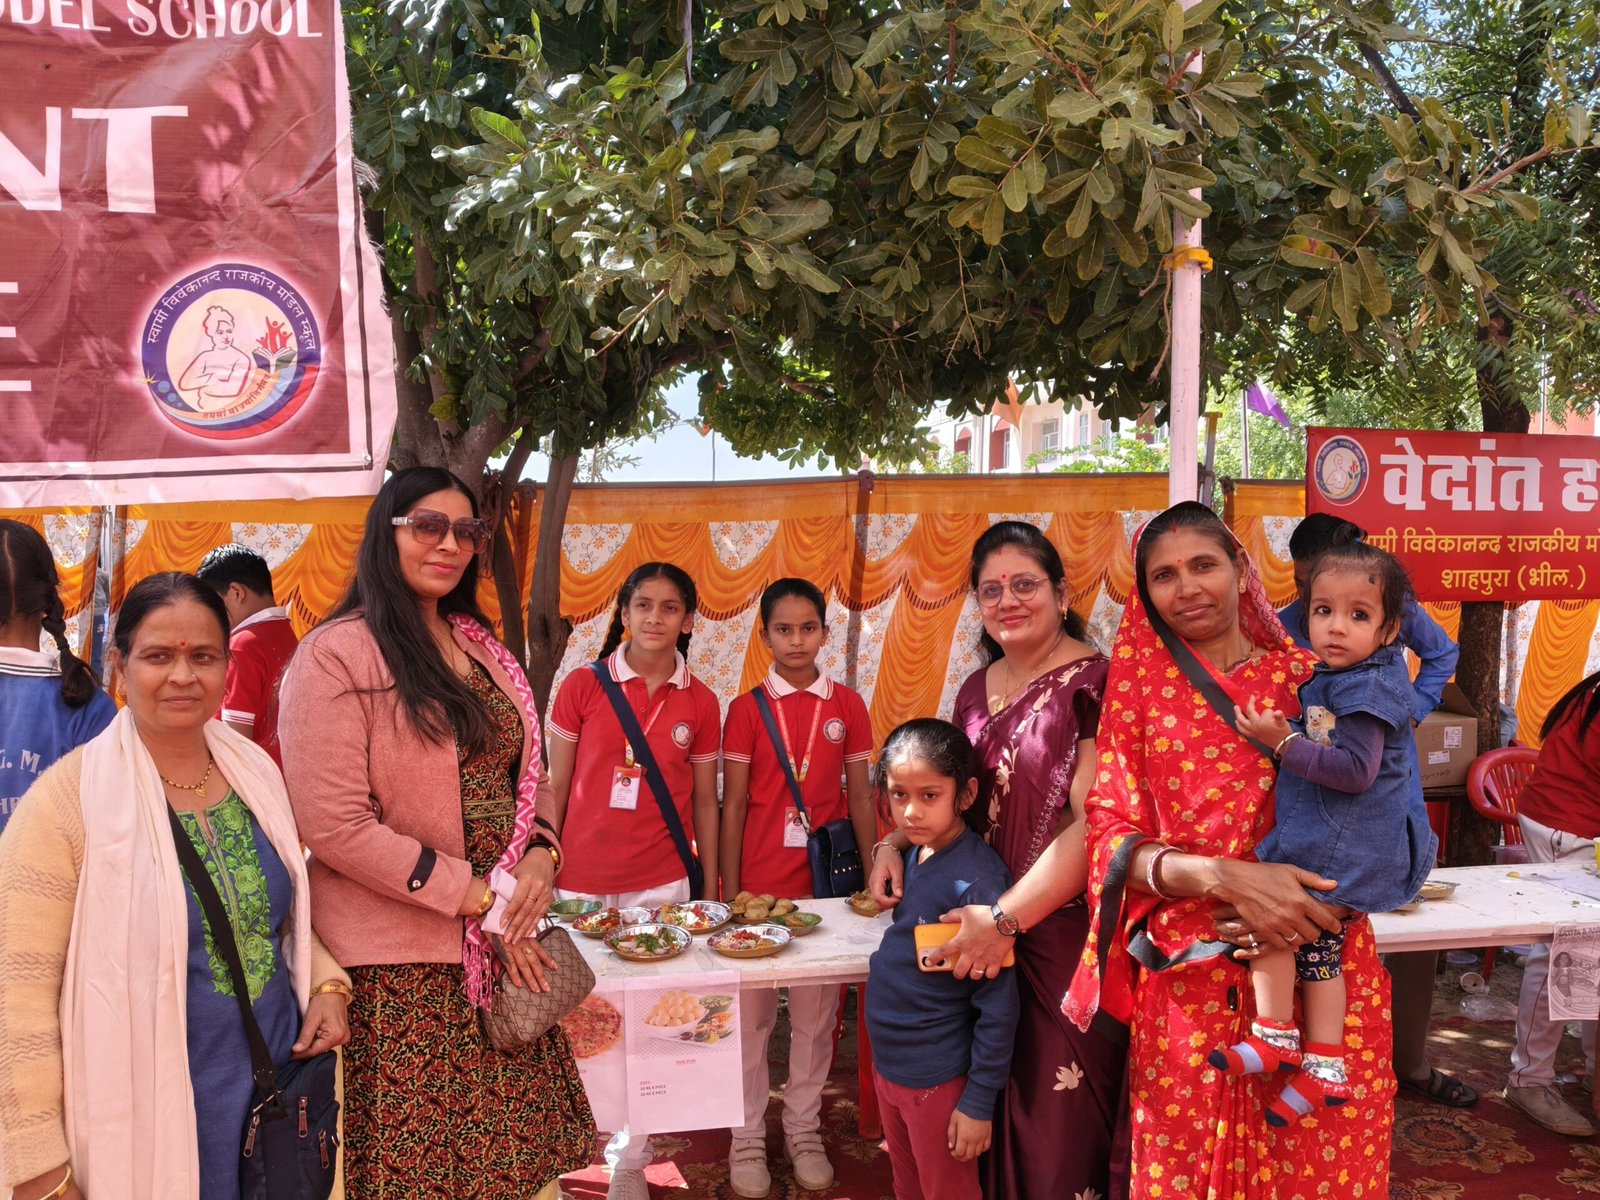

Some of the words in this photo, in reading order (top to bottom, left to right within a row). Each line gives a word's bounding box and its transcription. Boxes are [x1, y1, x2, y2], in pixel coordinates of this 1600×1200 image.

[0, 0, 110, 31] DEL
[147, 309, 169, 343] स्वामी
[161, 270, 221, 310] विवेकानन्द
[223, 269, 276, 291] राजकीय
[277, 286, 305, 317] मॉडल
[299, 317, 316, 350] स्कूल
[1380, 437, 1544, 512] वेदांत
[1402, 526, 1502, 554] विवेकानन्द
[1507, 526, 1581, 553] राजकीय
[1441, 569, 1511, 596] शाहपुरा
